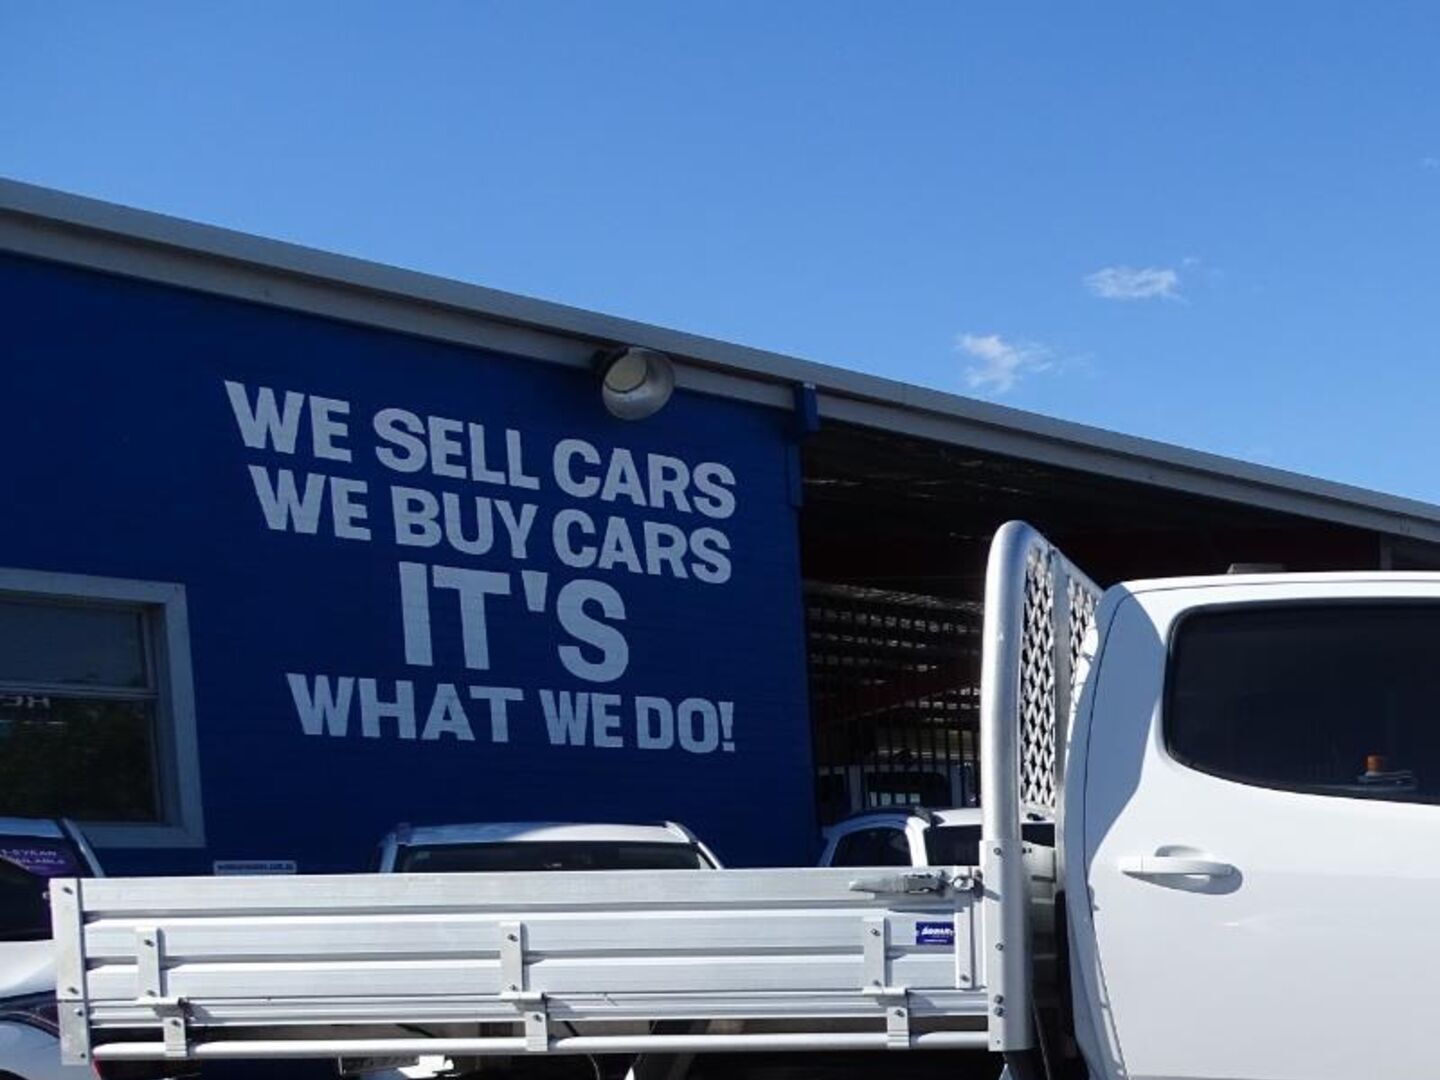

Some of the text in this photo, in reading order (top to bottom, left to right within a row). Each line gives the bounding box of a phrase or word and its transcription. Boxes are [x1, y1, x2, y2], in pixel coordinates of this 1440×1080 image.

[224, 380, 737, 519] WE SELL CARS
[248, 464, 732, 584] WE BUY CARS
[399, 561, 629, 683] IT'S
[286, 673, 736, 754] WHAT WE DO!
